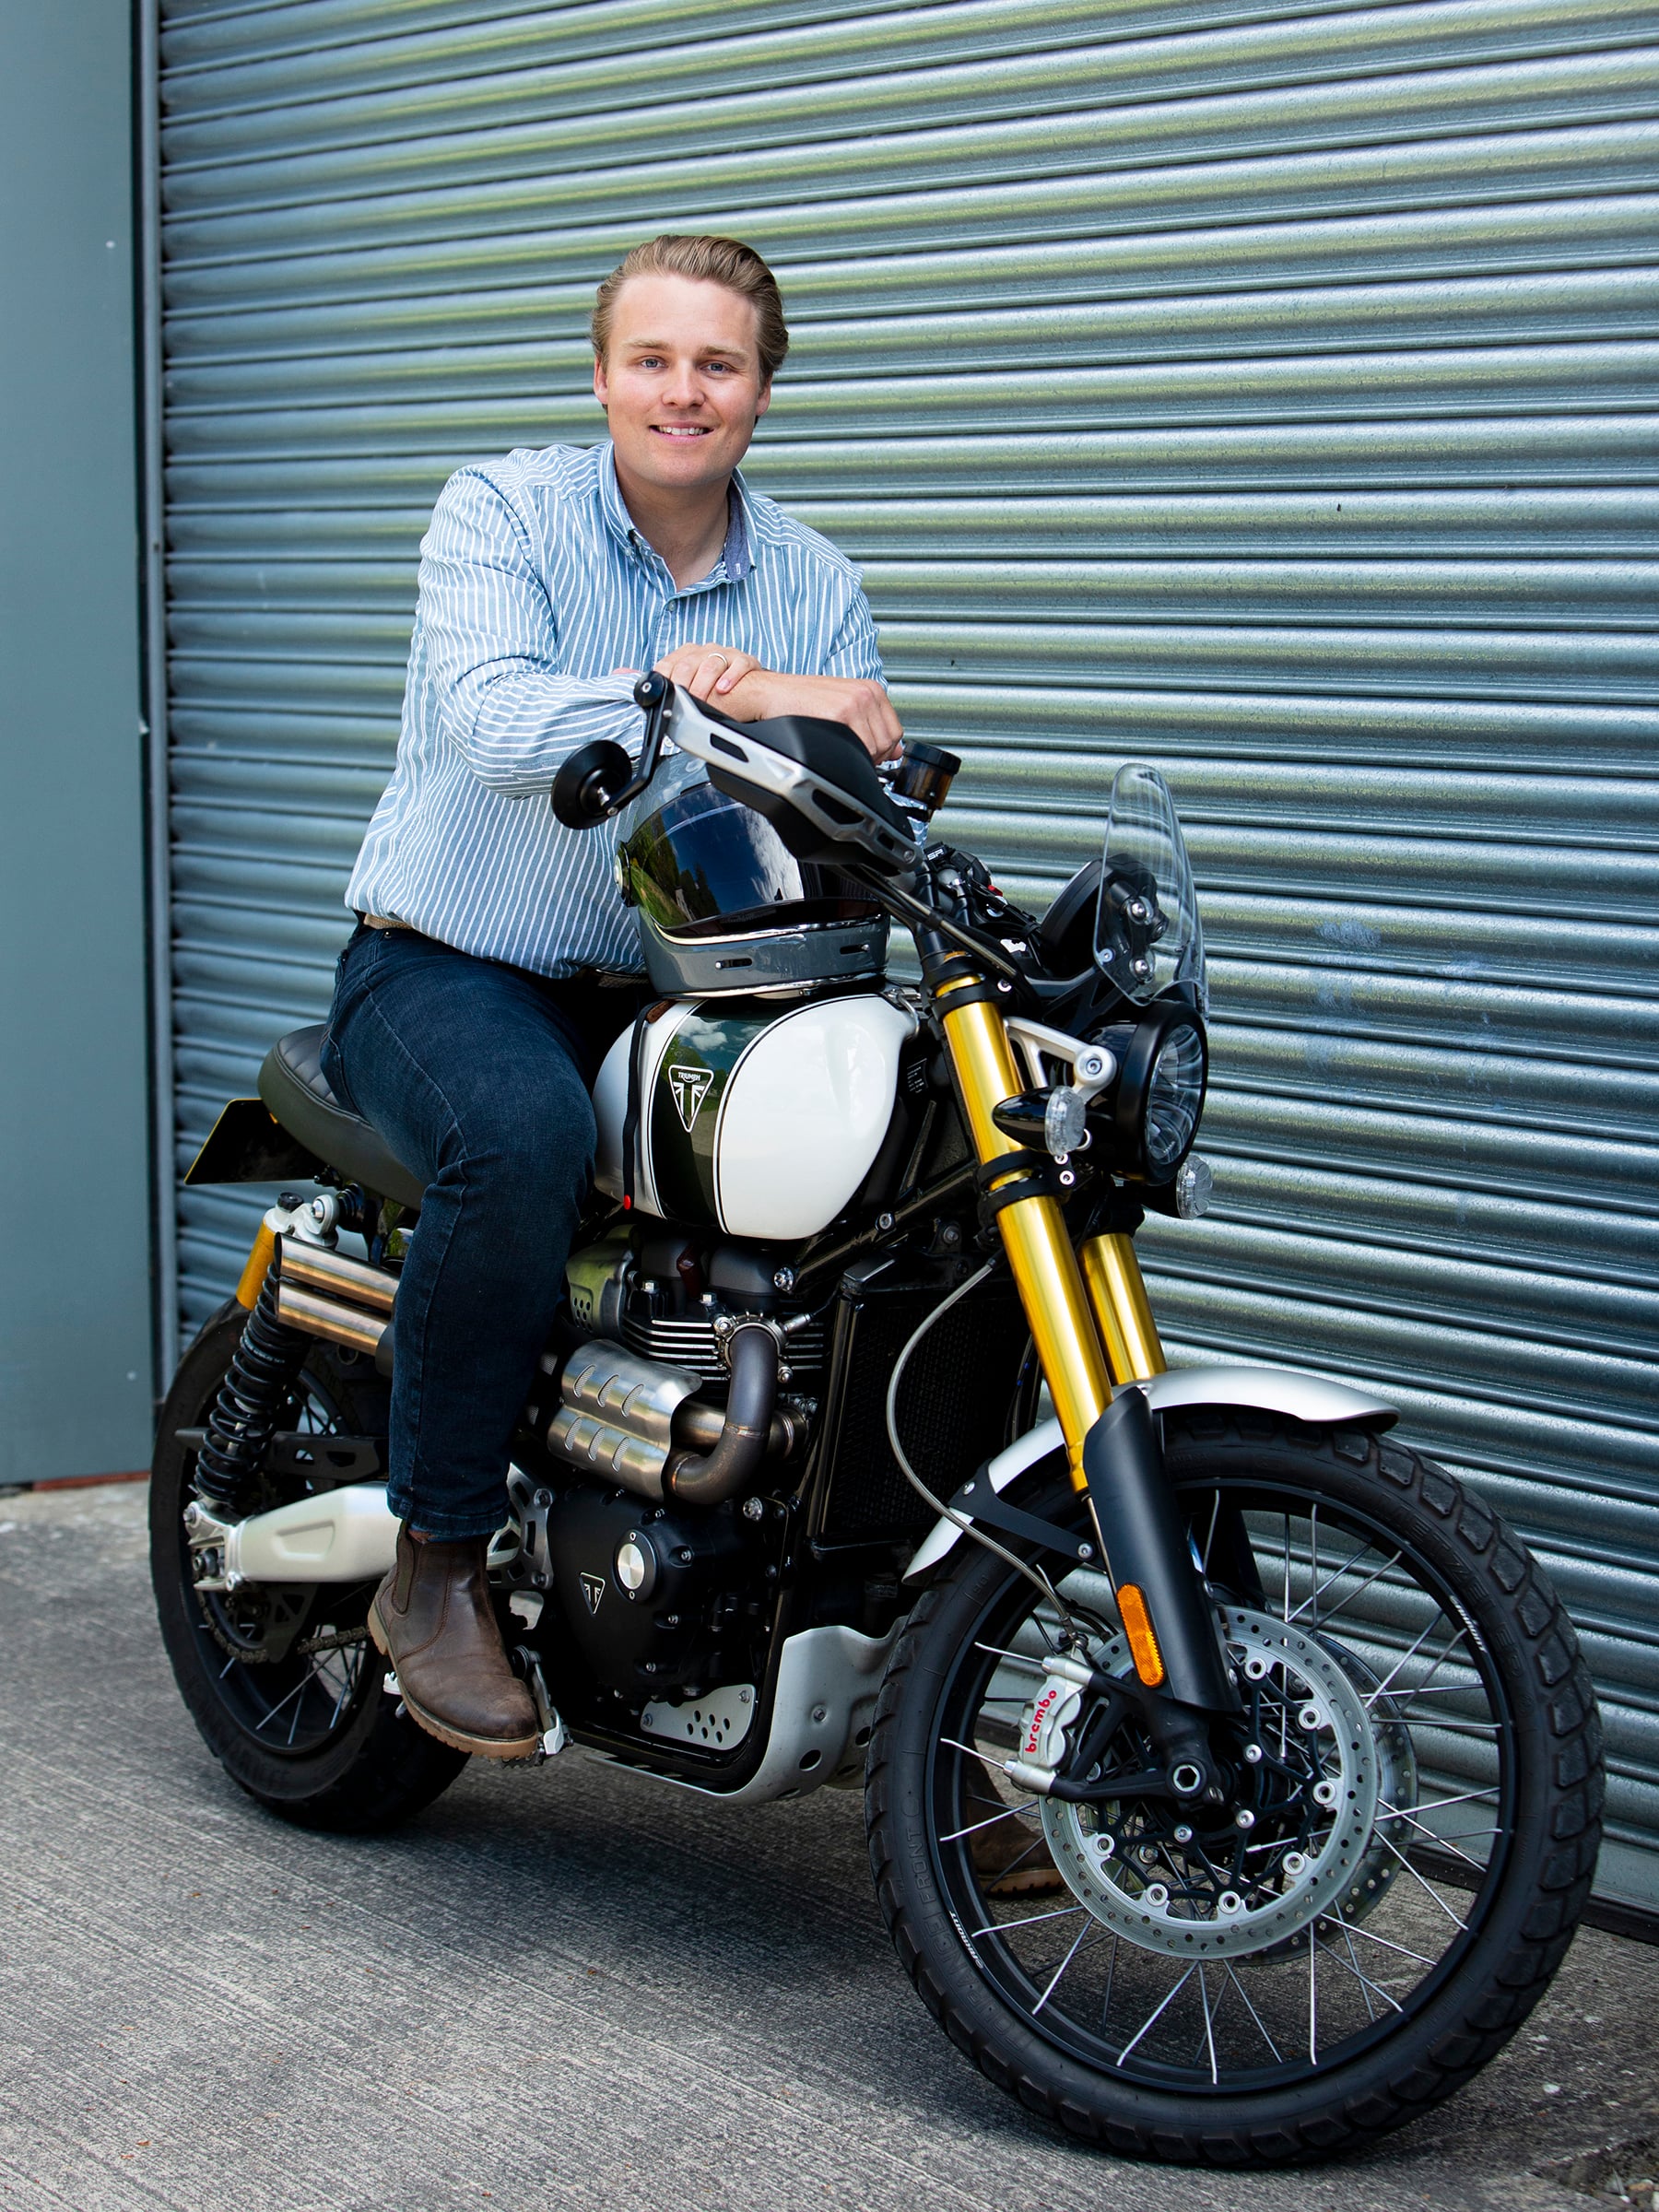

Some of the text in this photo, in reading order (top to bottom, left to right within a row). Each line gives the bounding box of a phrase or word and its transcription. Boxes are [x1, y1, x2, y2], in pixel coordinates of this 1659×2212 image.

[677, 1071, 701, 1082] TRIUMPH
[1024, 1689, 1058, 1753] brembo
[906, 1828, 937, 1904] FRONT
[923, 1913, 1026, 2052] TOURANCE
